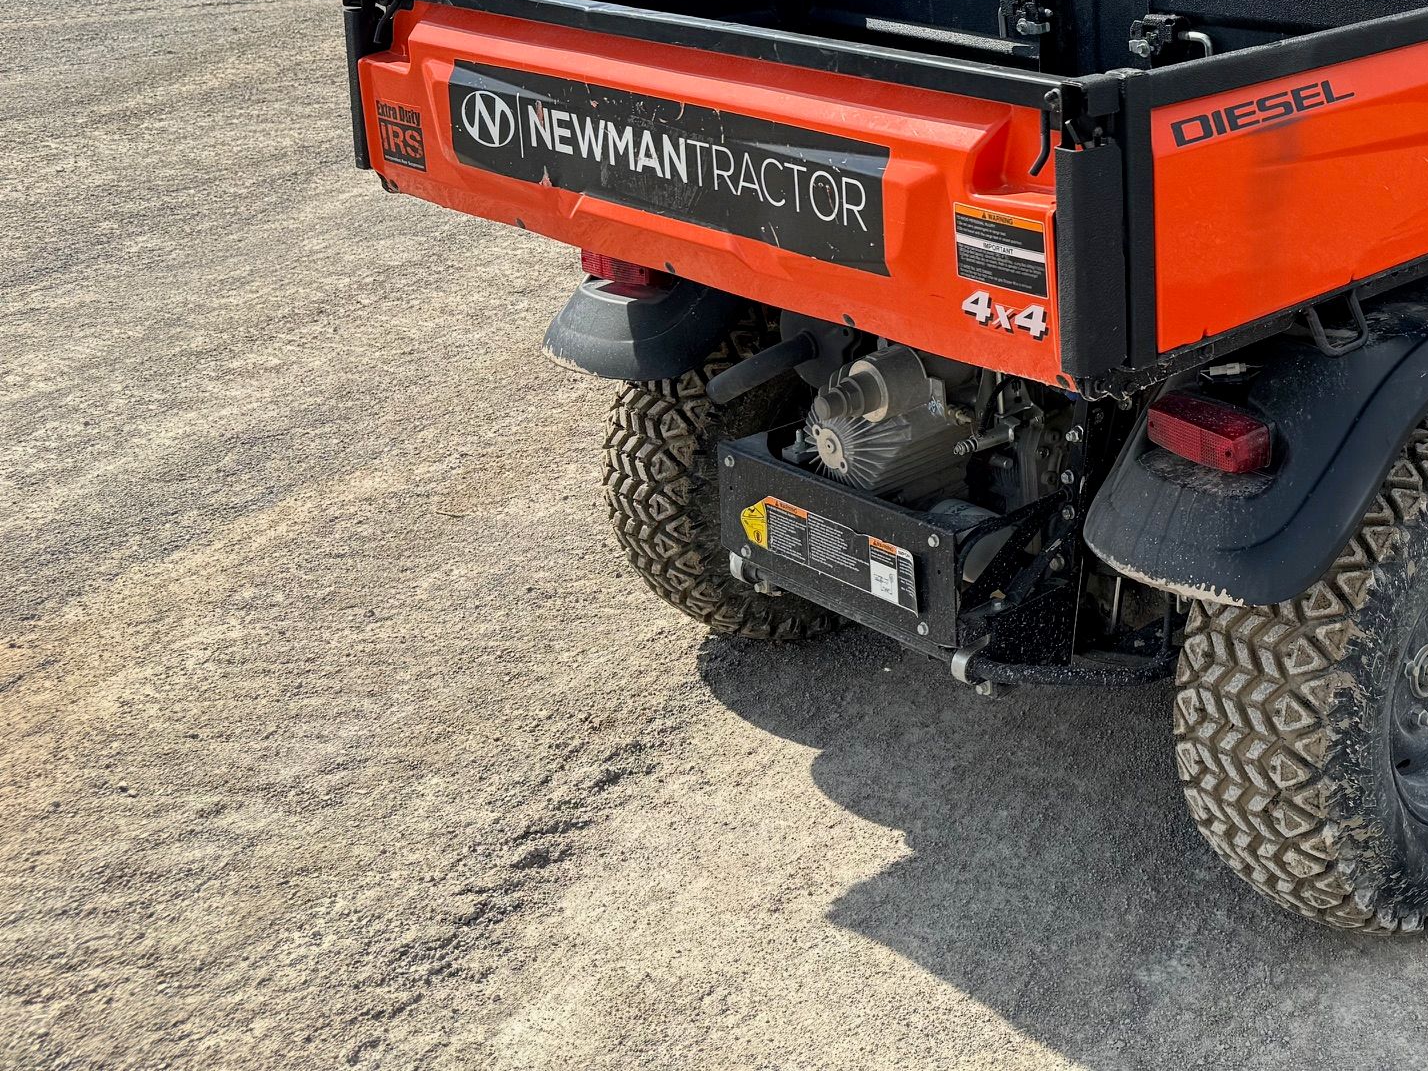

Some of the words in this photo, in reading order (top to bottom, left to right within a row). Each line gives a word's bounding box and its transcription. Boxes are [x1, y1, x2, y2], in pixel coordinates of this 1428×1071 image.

[376, 100, 397, 120] Extra
[398, 105, 420, 126] Duty
[1170, 80, 1355, 148] DIESEL
[380, 122, 423, 159] IRS
[988, 213, 1014, 225] WARNING
[982, 242, 1013, 255] IMPORTANT
[962, 291, 1049, 341] 4x4
